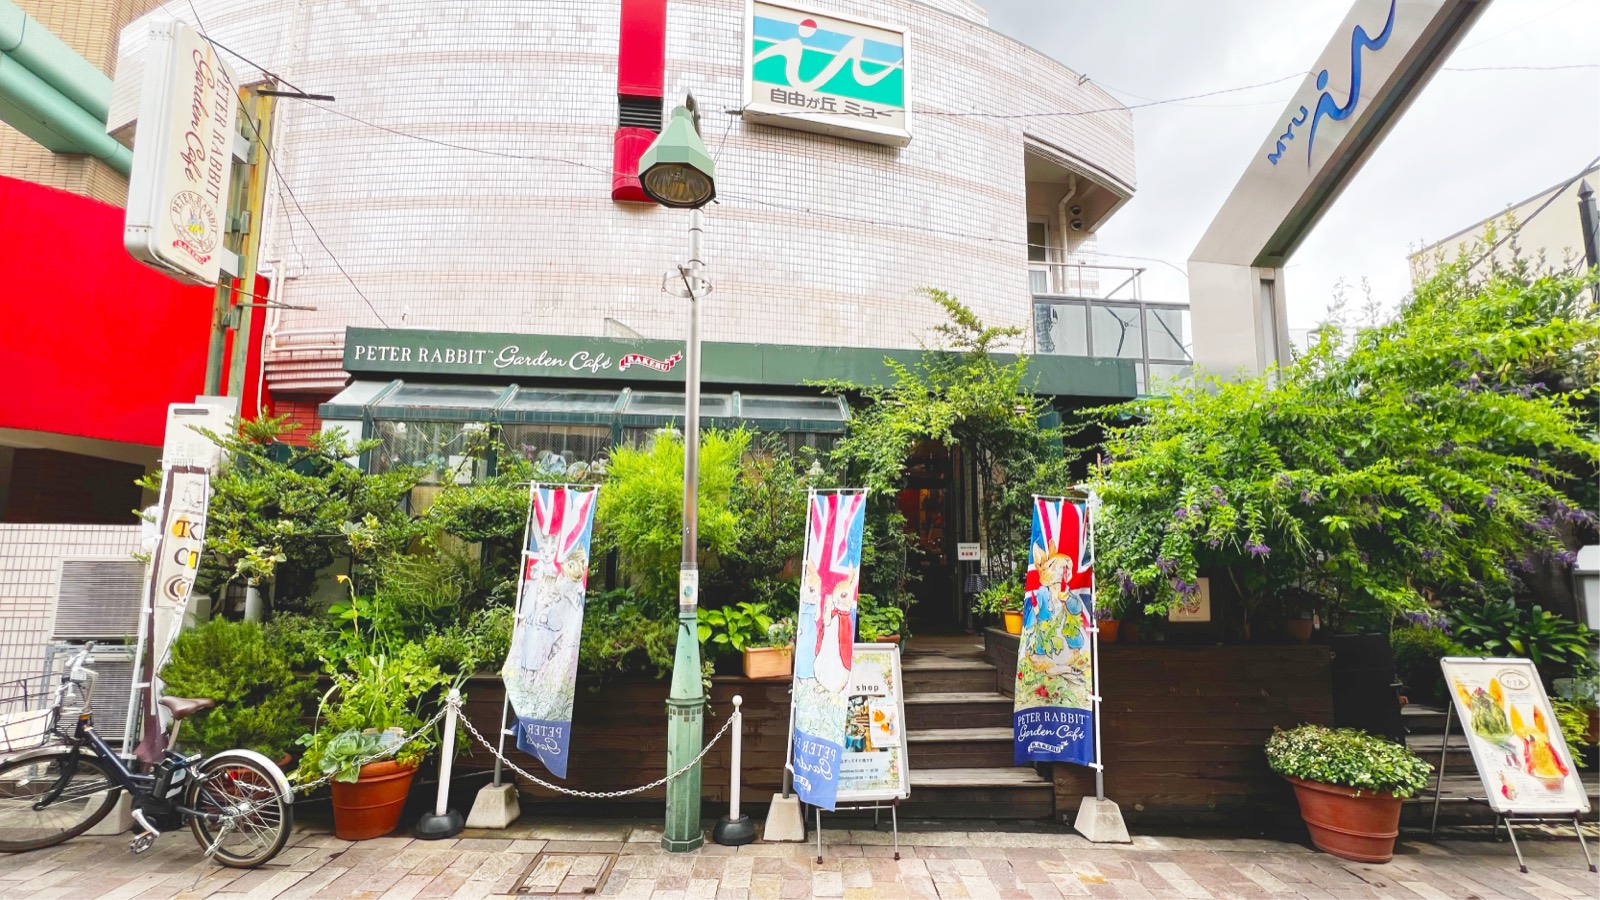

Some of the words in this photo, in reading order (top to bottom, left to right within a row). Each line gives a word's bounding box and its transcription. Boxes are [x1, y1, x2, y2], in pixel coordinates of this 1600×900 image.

[191, 49, 215, 131] Garden
[215, 66, 229, 127] PETER
[770, 88, 837, 113] 自由が丘
[844, 100, 892, 119] ミュー
[1267, 105, 1308, 165] MYU
[206, 129, 225, 204] RABBIT
[354, 345, 412, 362] PETER
[418, 347, 487, 365] RABBIT
[493, 345, 567, 368] Garden
[856, 684, 879, 692] shop
[1017, 711, 1041, 726] PETER
[1044, 711, 1085, 725] RABBIT
[1018, 724, 1055, 742] Garden
